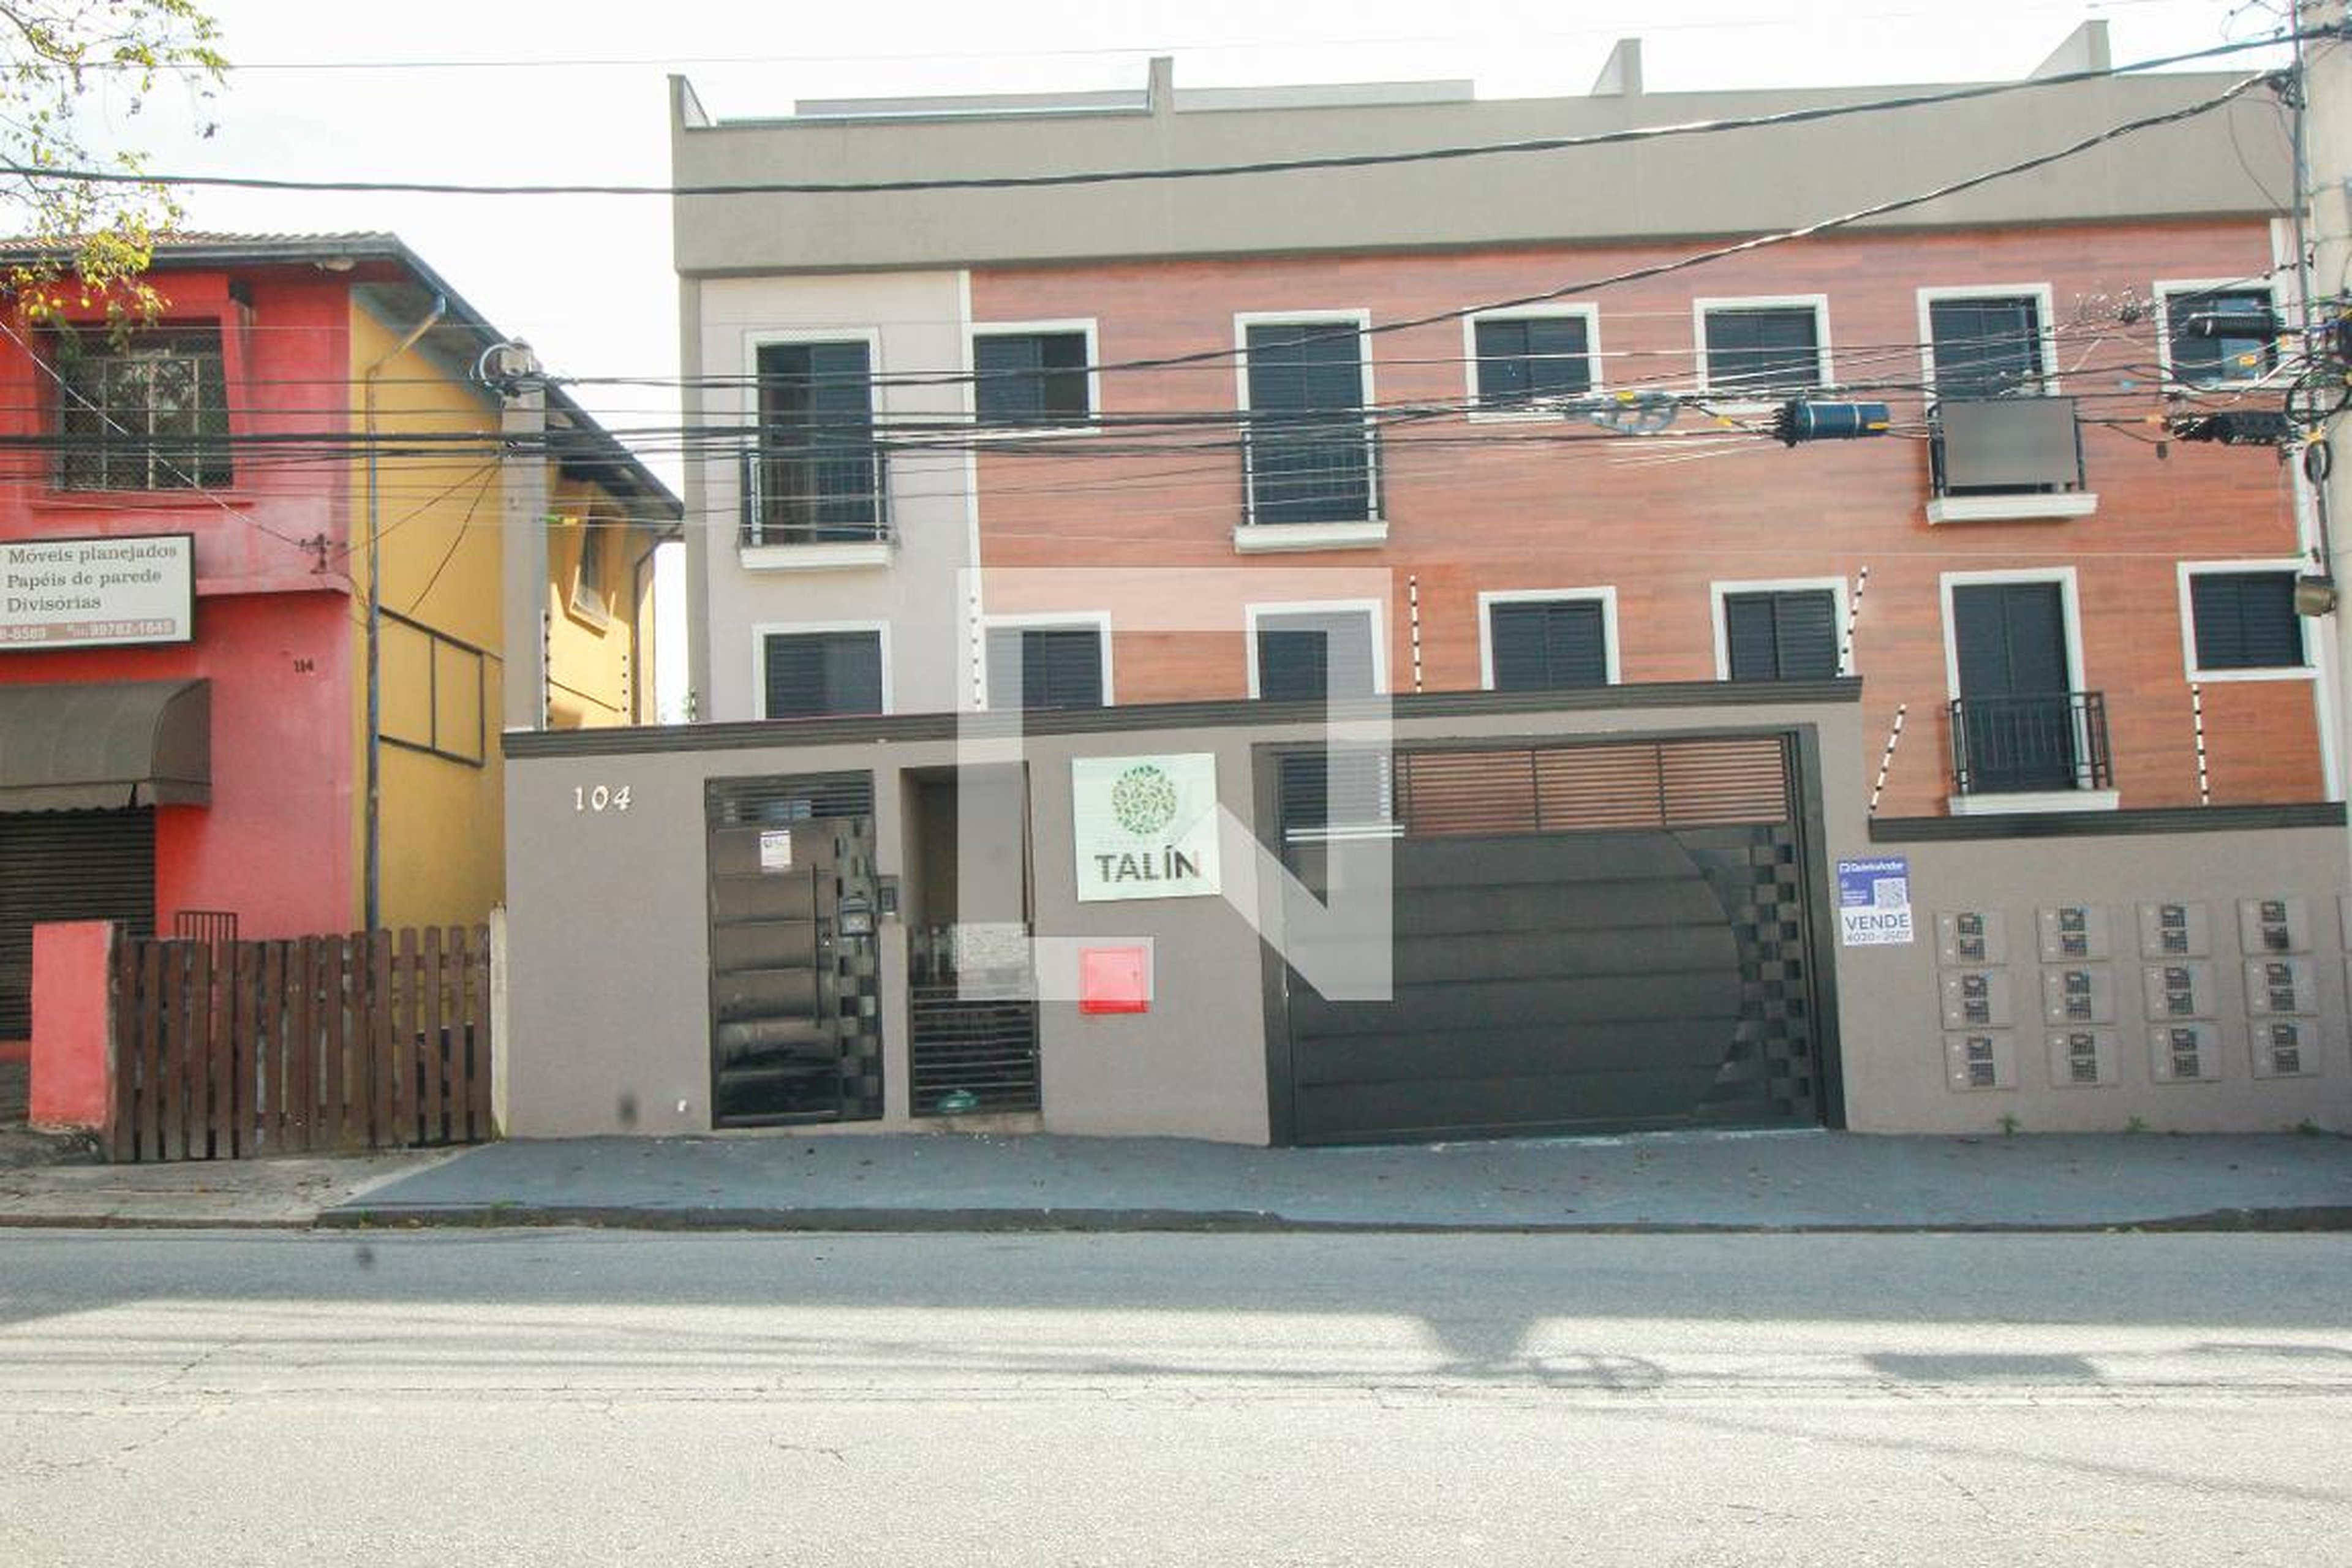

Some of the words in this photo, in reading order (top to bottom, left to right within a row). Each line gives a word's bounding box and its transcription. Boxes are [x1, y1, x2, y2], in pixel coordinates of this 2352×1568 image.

[80, 545, 176, 564] planejados
[7, 572, 66, 590] Papéis
[72, 571, 92, 584] de
[100, 569, 162, 588] parede
[7, 595, 100, 612] Divisórias
[293, 658, 314, 673] 114
[575, 785, 631, 810] 104
[1094, 845, 1200, 882] TALÍN
[1845, 914, 1910, 930] VENDE
